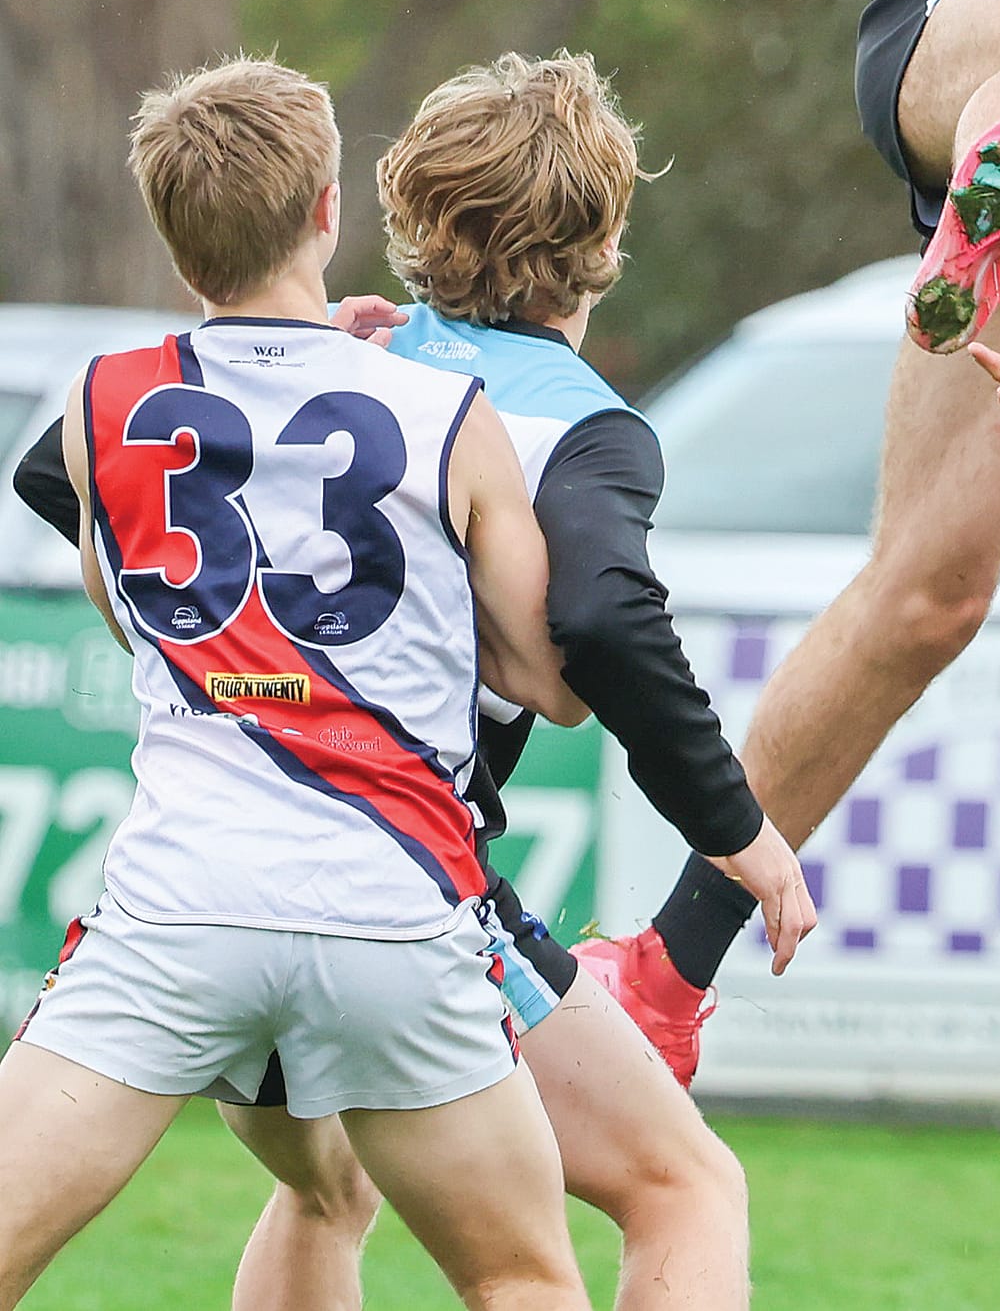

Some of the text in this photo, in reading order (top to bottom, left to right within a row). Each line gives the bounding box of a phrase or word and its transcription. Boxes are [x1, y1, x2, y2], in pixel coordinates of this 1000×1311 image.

[118, 383, 408, 646] 33
[313, 622, 349, 631] Gippsland
[254, 679, 305, 702] TWENTY
[318, 725, 353, 744] Club
